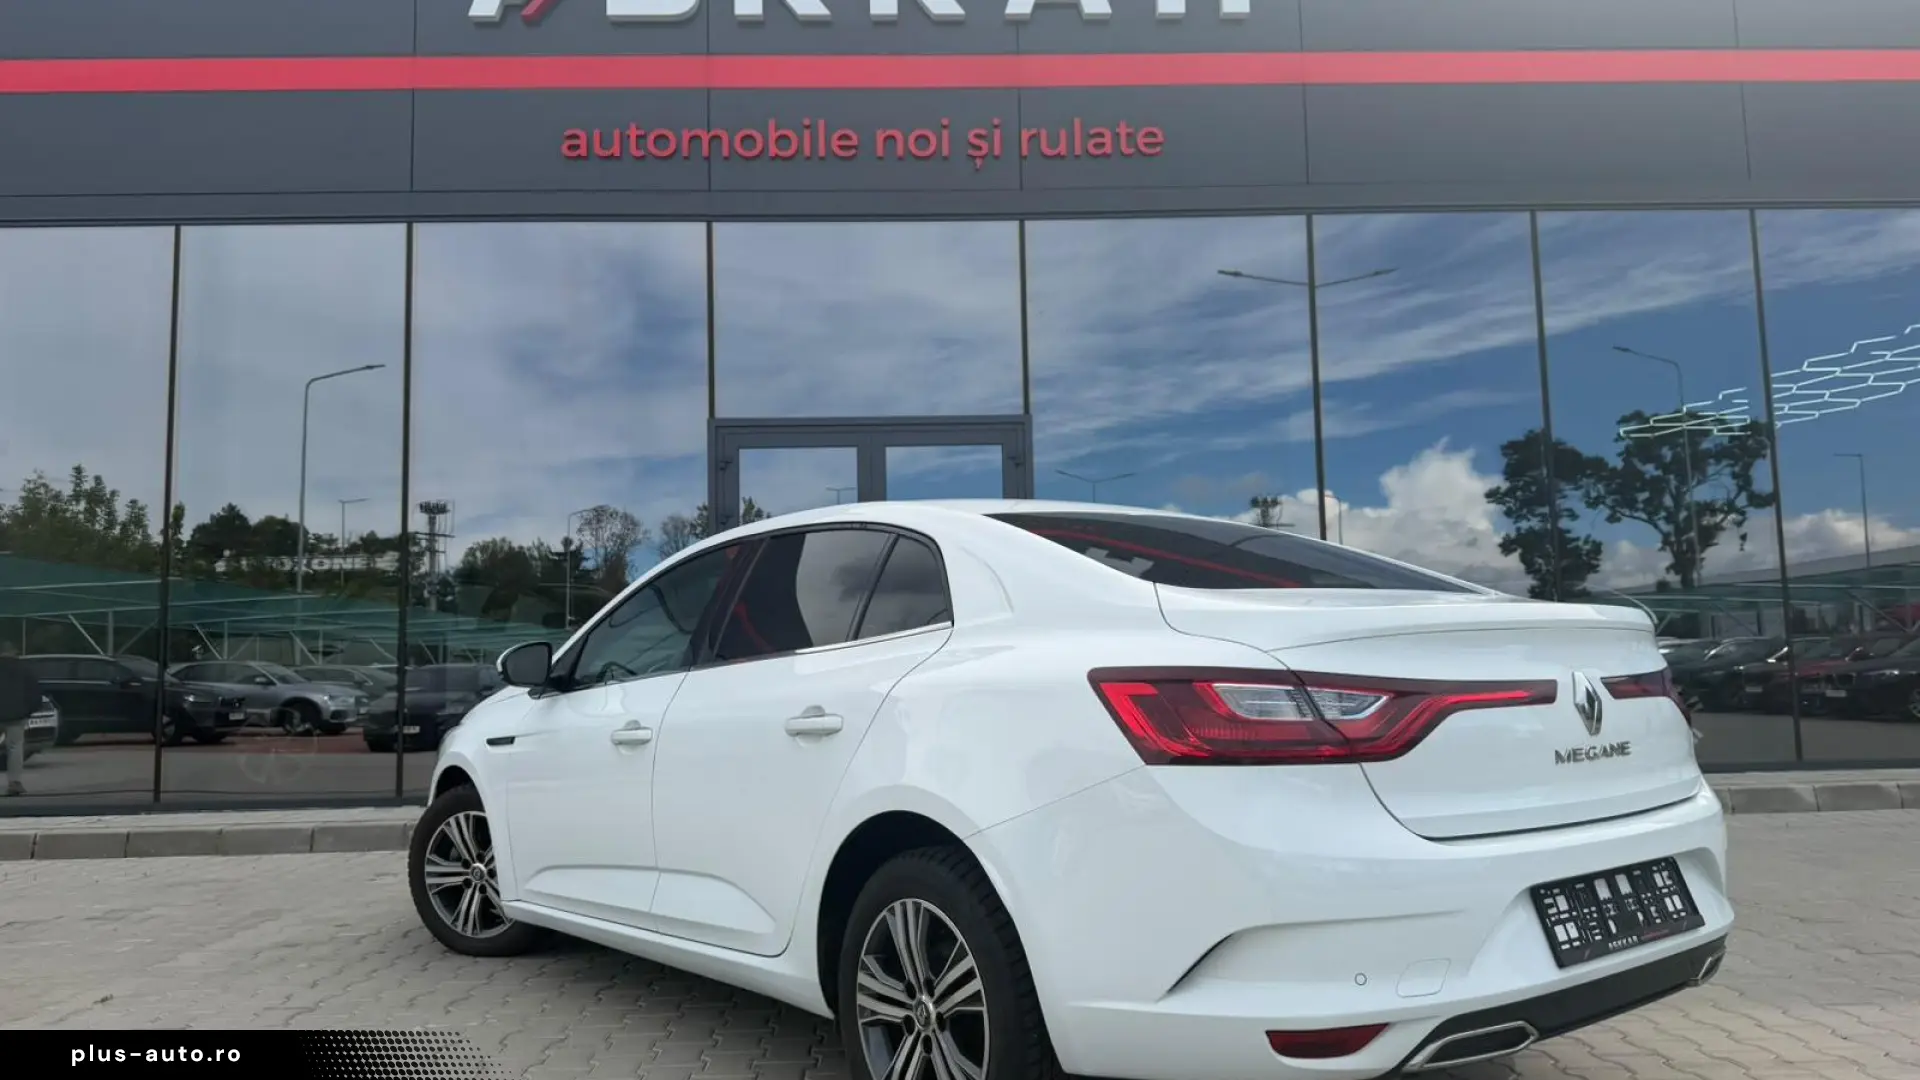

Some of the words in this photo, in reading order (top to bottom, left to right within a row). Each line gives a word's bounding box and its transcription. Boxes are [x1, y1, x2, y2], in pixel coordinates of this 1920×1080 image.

[559, 117, 861, 159] automobile
[875, 117, 950, 159] noi
[1019, 117, 1165, 158] rulate
[1554, 740, 1632, 766] MEGANE
